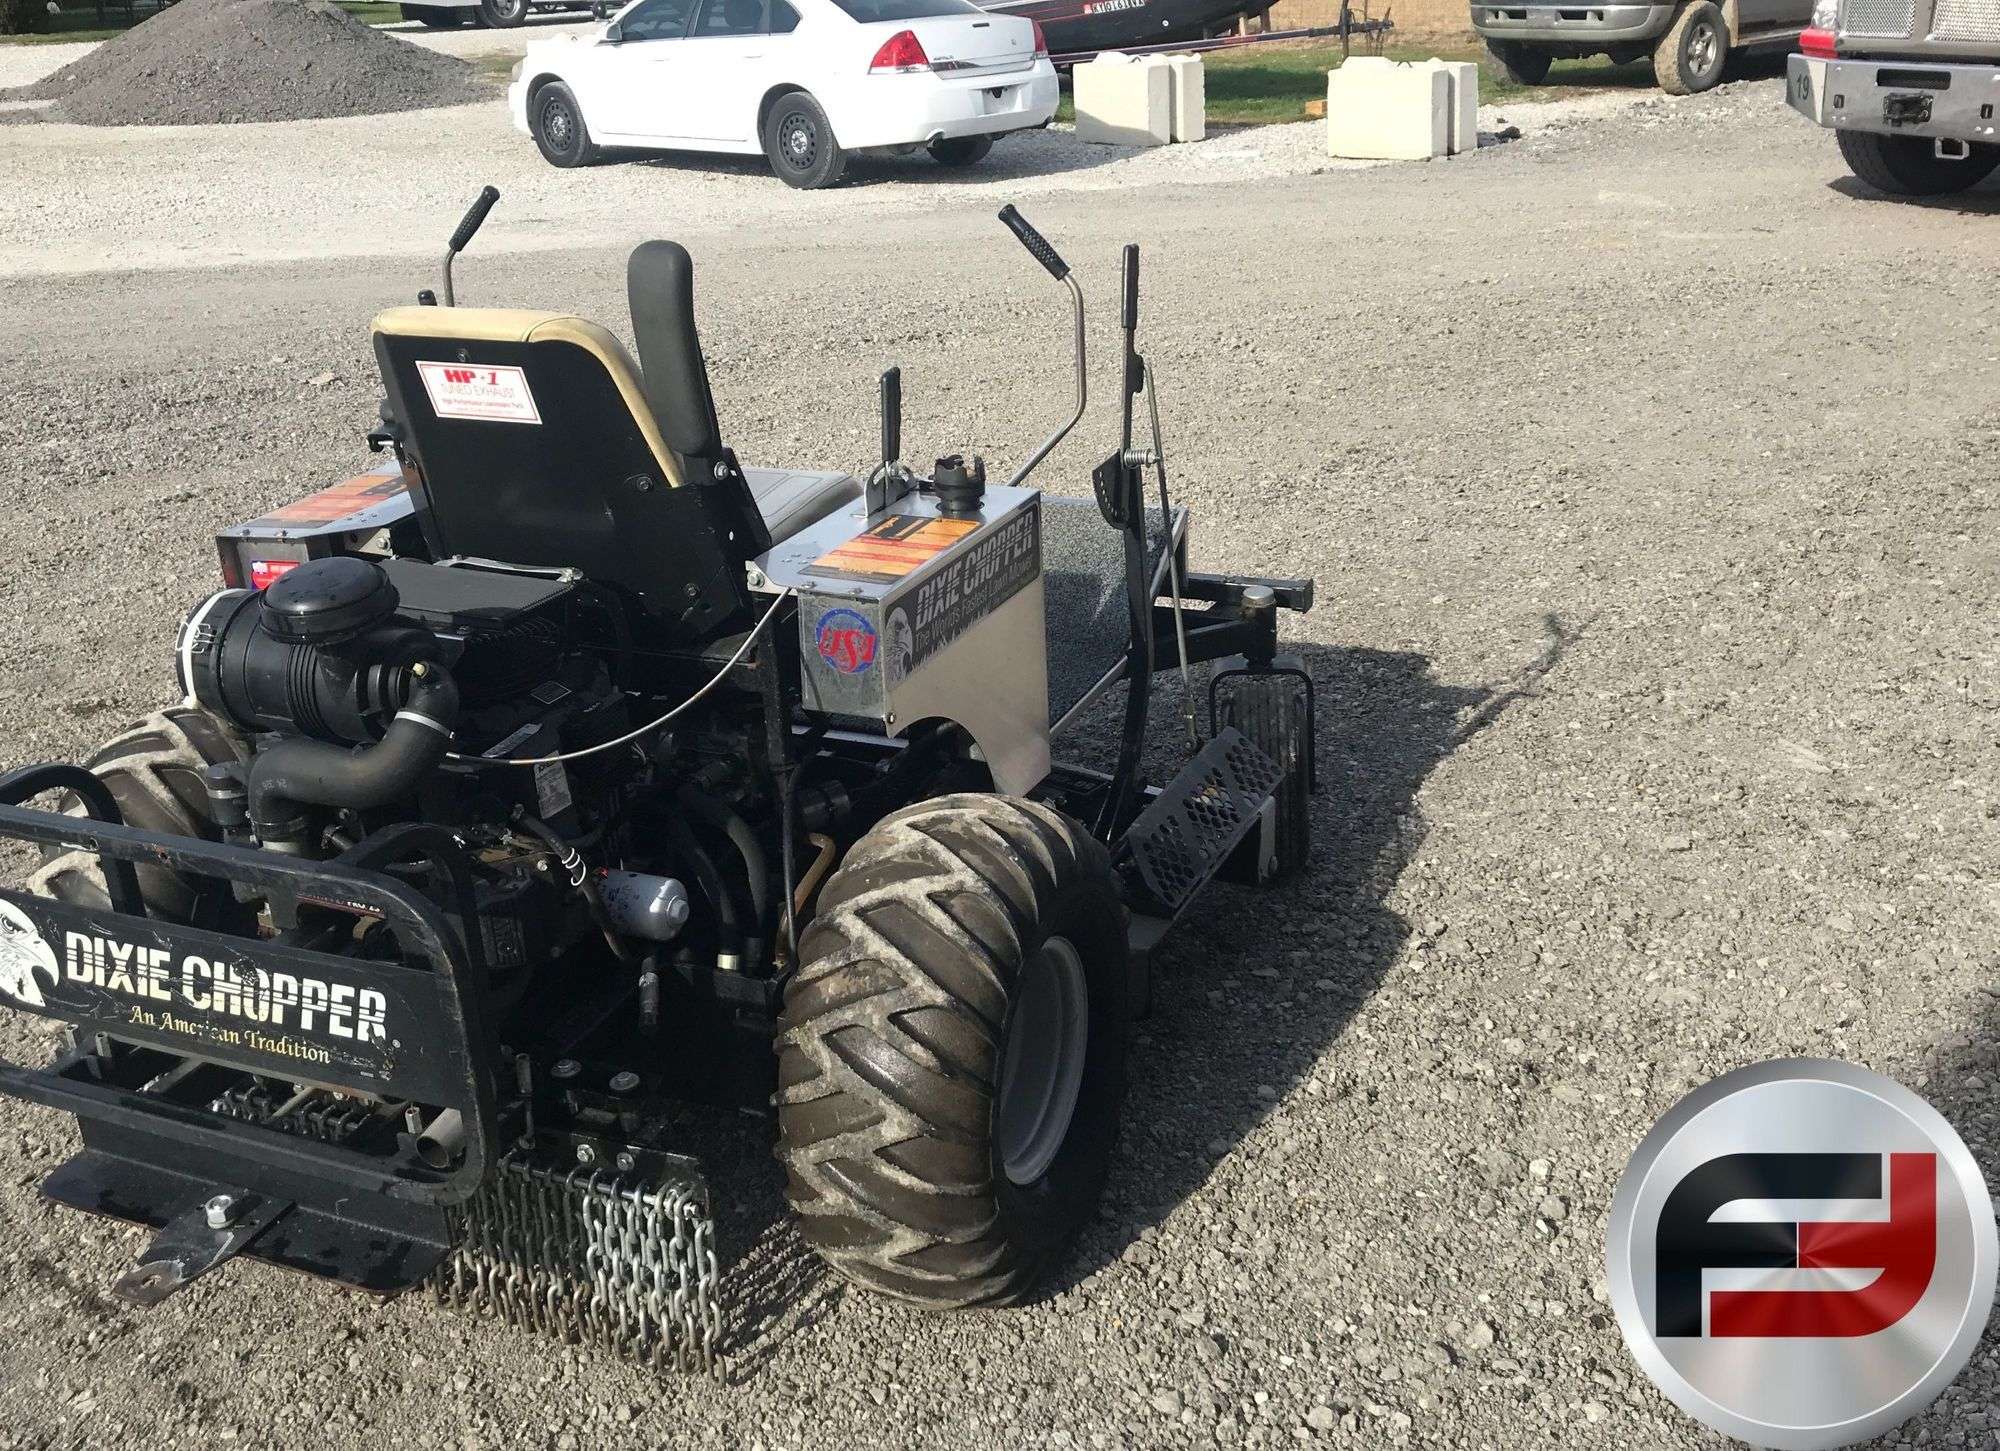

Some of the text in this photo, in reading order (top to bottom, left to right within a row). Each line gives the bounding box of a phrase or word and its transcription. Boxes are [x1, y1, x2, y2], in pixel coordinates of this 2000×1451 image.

[1796, 74, 1810, 100] 19
[65, 930, 388, 1043] DIXIE CHOPPER
[129, 1005, 156, 1025] An
[244, 1028, 331, 1064] Tradition
